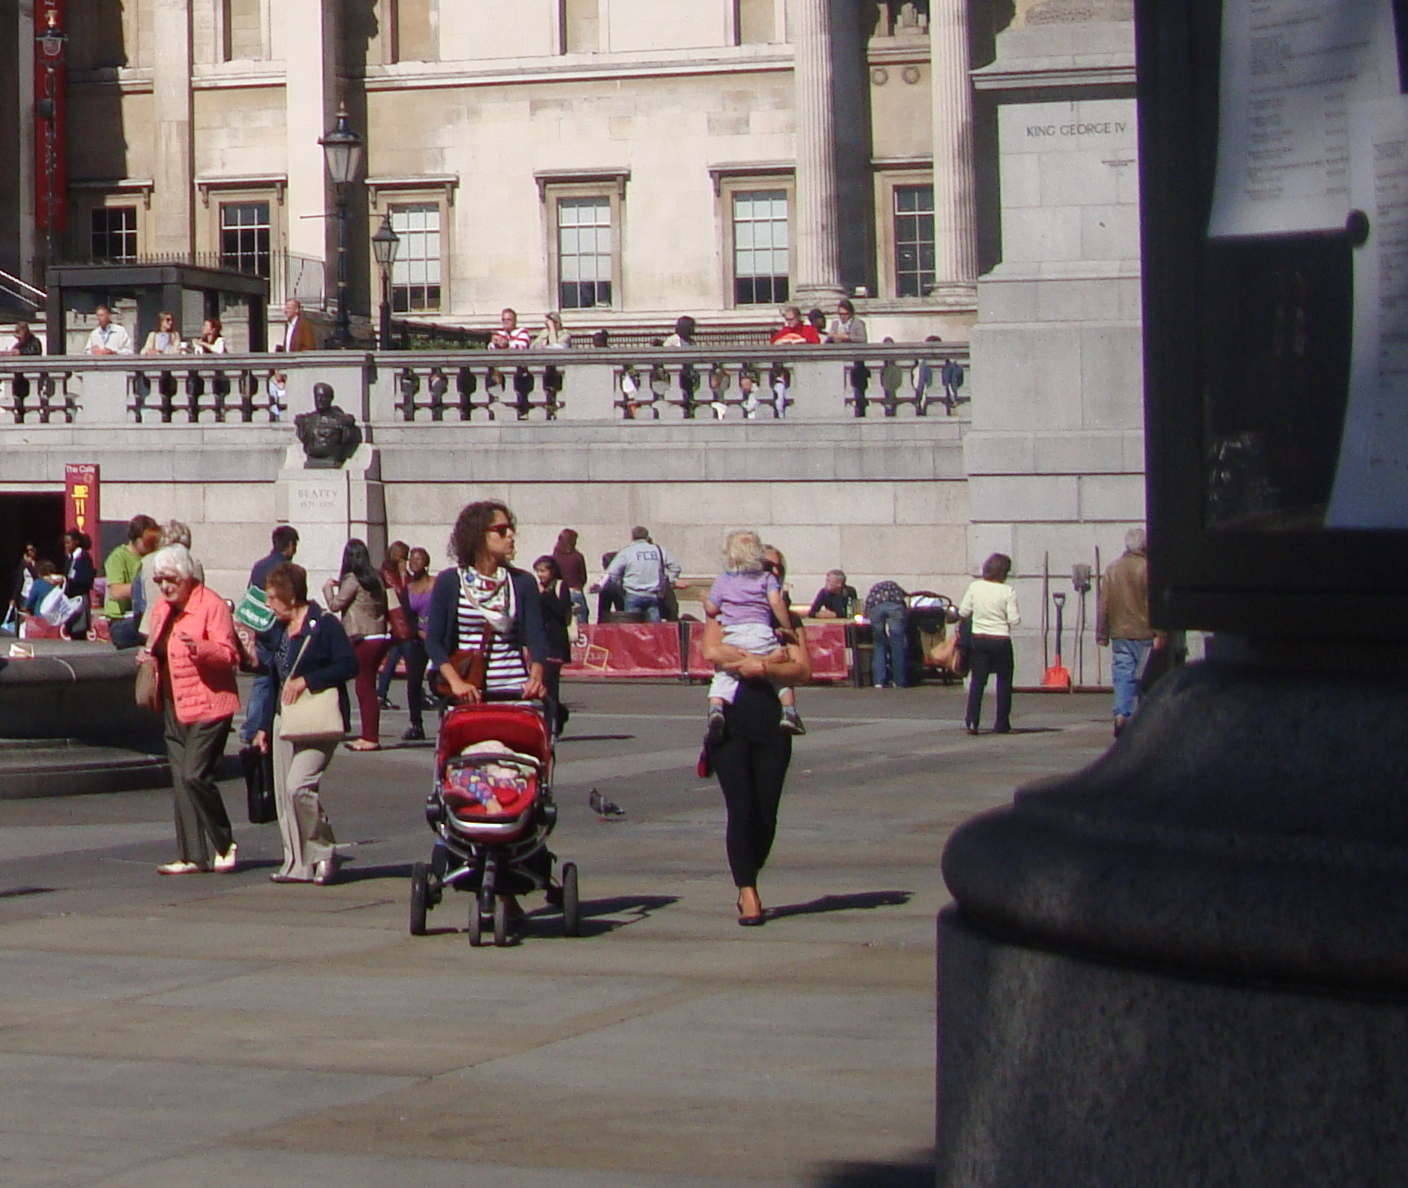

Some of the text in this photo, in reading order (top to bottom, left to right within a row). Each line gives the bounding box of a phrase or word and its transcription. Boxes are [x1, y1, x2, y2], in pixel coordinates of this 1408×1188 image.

[1026, 122, 1127, 138] KING GEORGE IV
